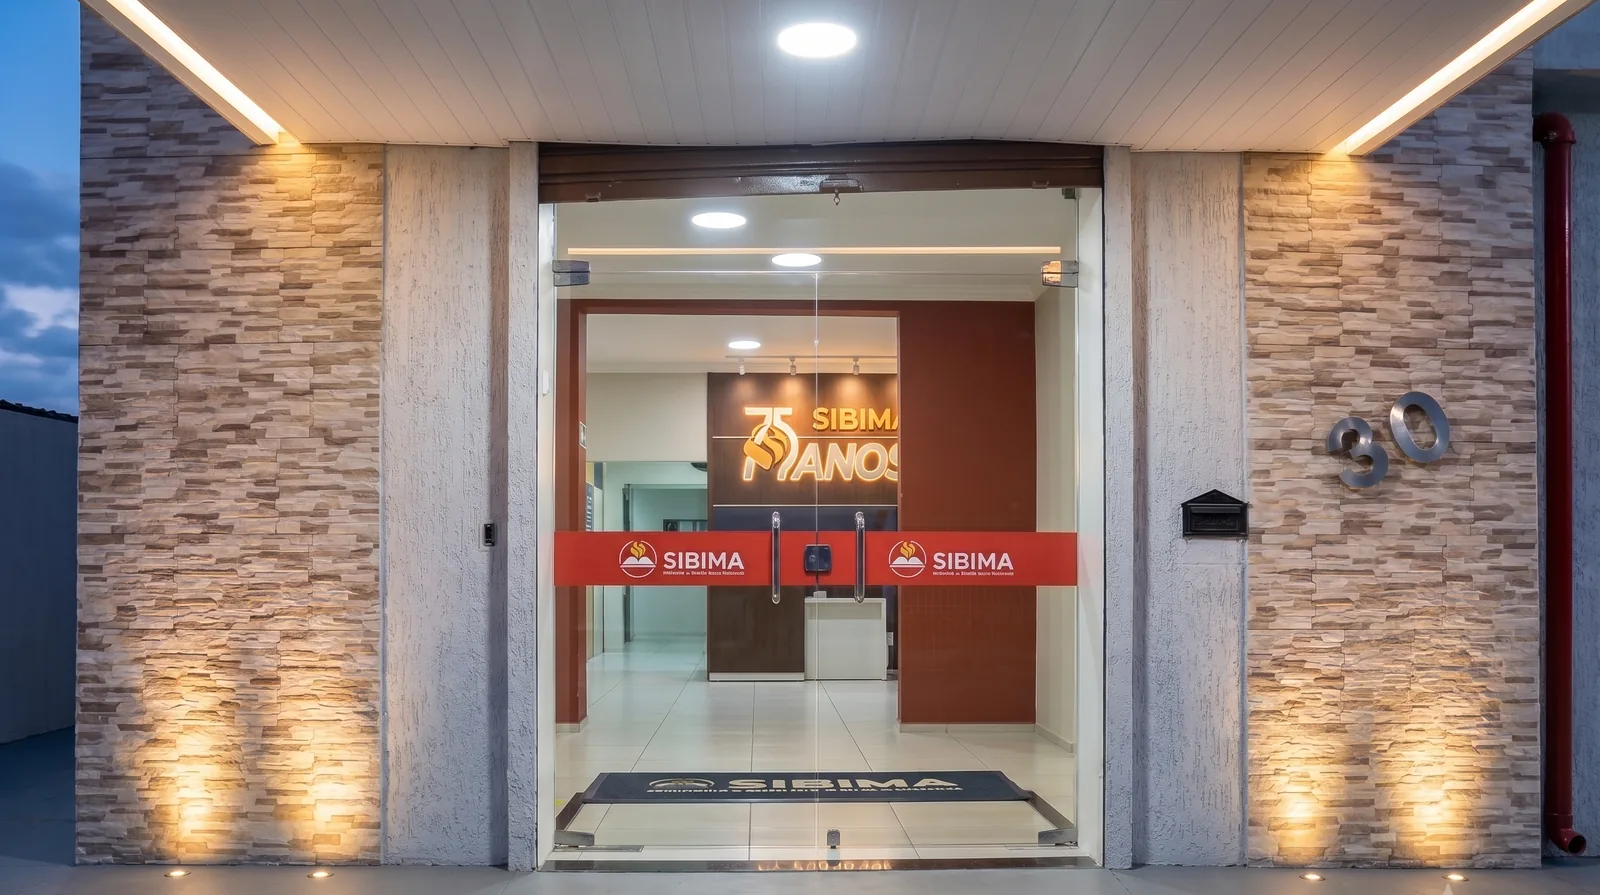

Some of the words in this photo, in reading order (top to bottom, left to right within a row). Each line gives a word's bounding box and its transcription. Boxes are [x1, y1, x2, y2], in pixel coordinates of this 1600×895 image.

[812, 407, 898, 431] SIBIM
[1326, 391, 1450, 488] 30
[663, 551, 744, 570] SIBIMA
[932, 552, 1014, 570] SIBIMA
[728, 778, 959, 789] SIBIMA
